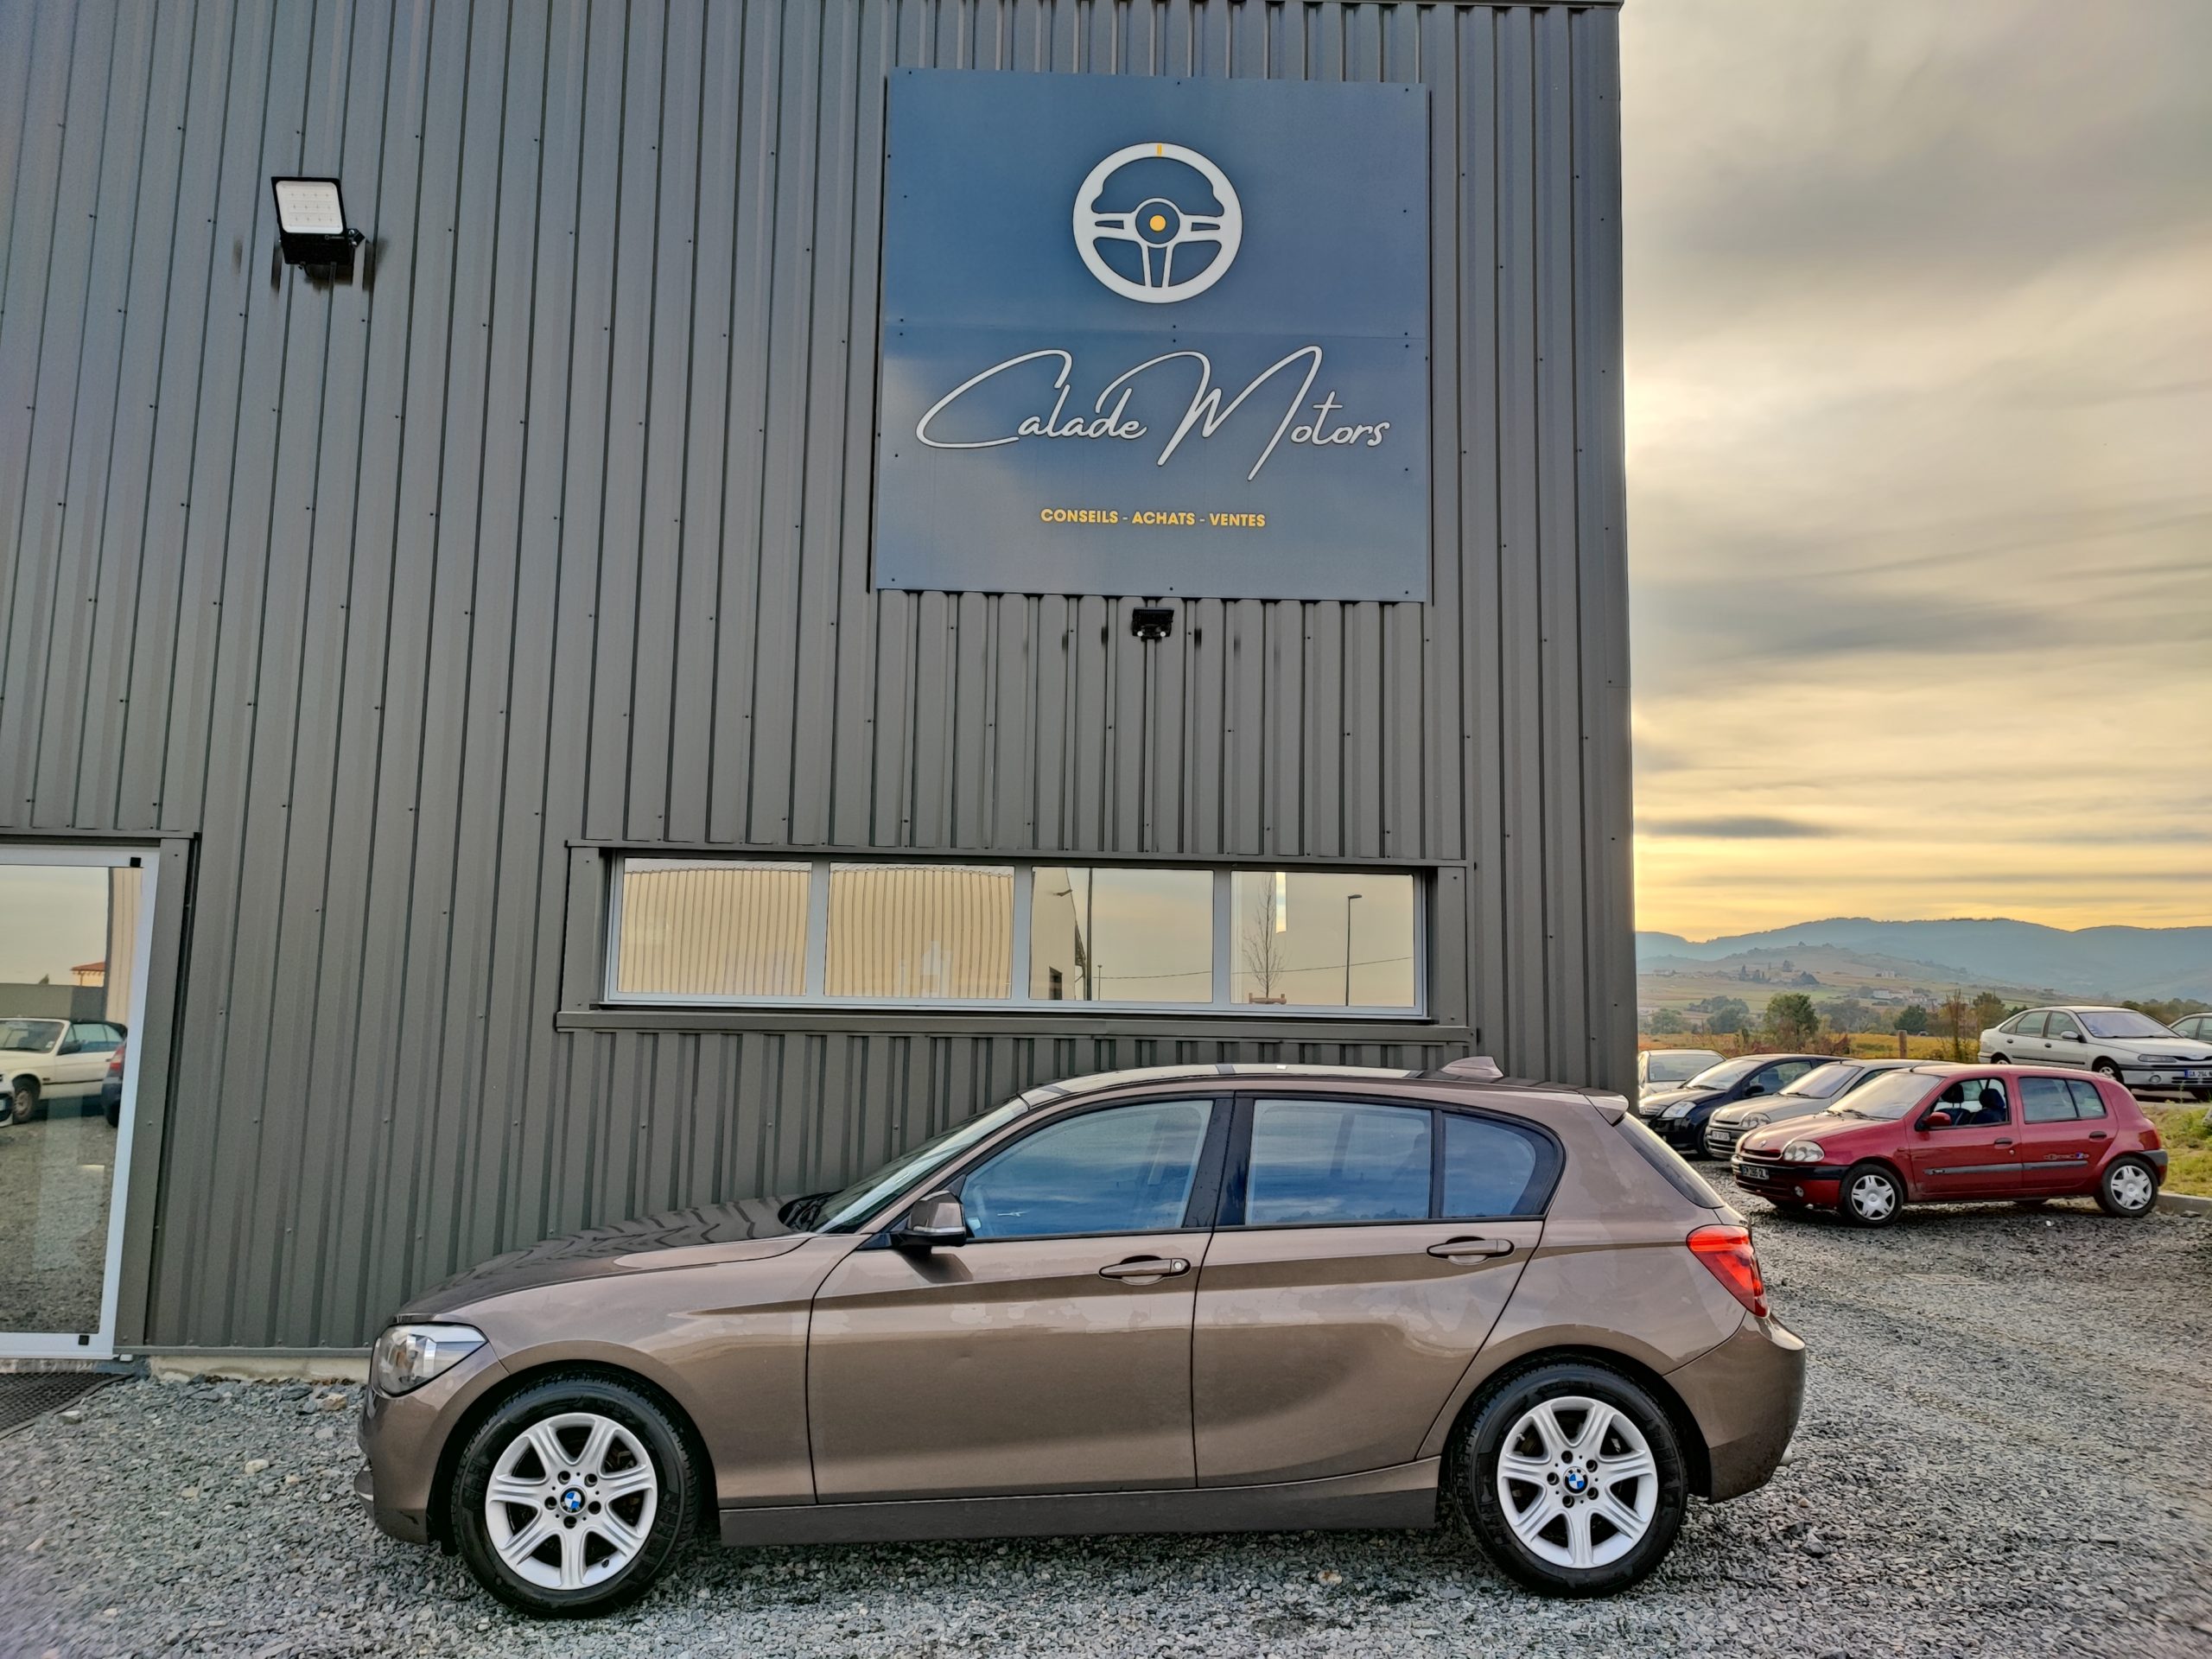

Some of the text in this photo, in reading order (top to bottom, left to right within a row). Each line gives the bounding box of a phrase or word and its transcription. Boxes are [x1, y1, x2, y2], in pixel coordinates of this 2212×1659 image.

[915, 345, 1390, 481] Calade Motors
[1040, 508, 1118, 524] CONSEILS
[1132, 512, 1195, 525] ACHATS
[1210, 513, 1266, 527] VENTES
